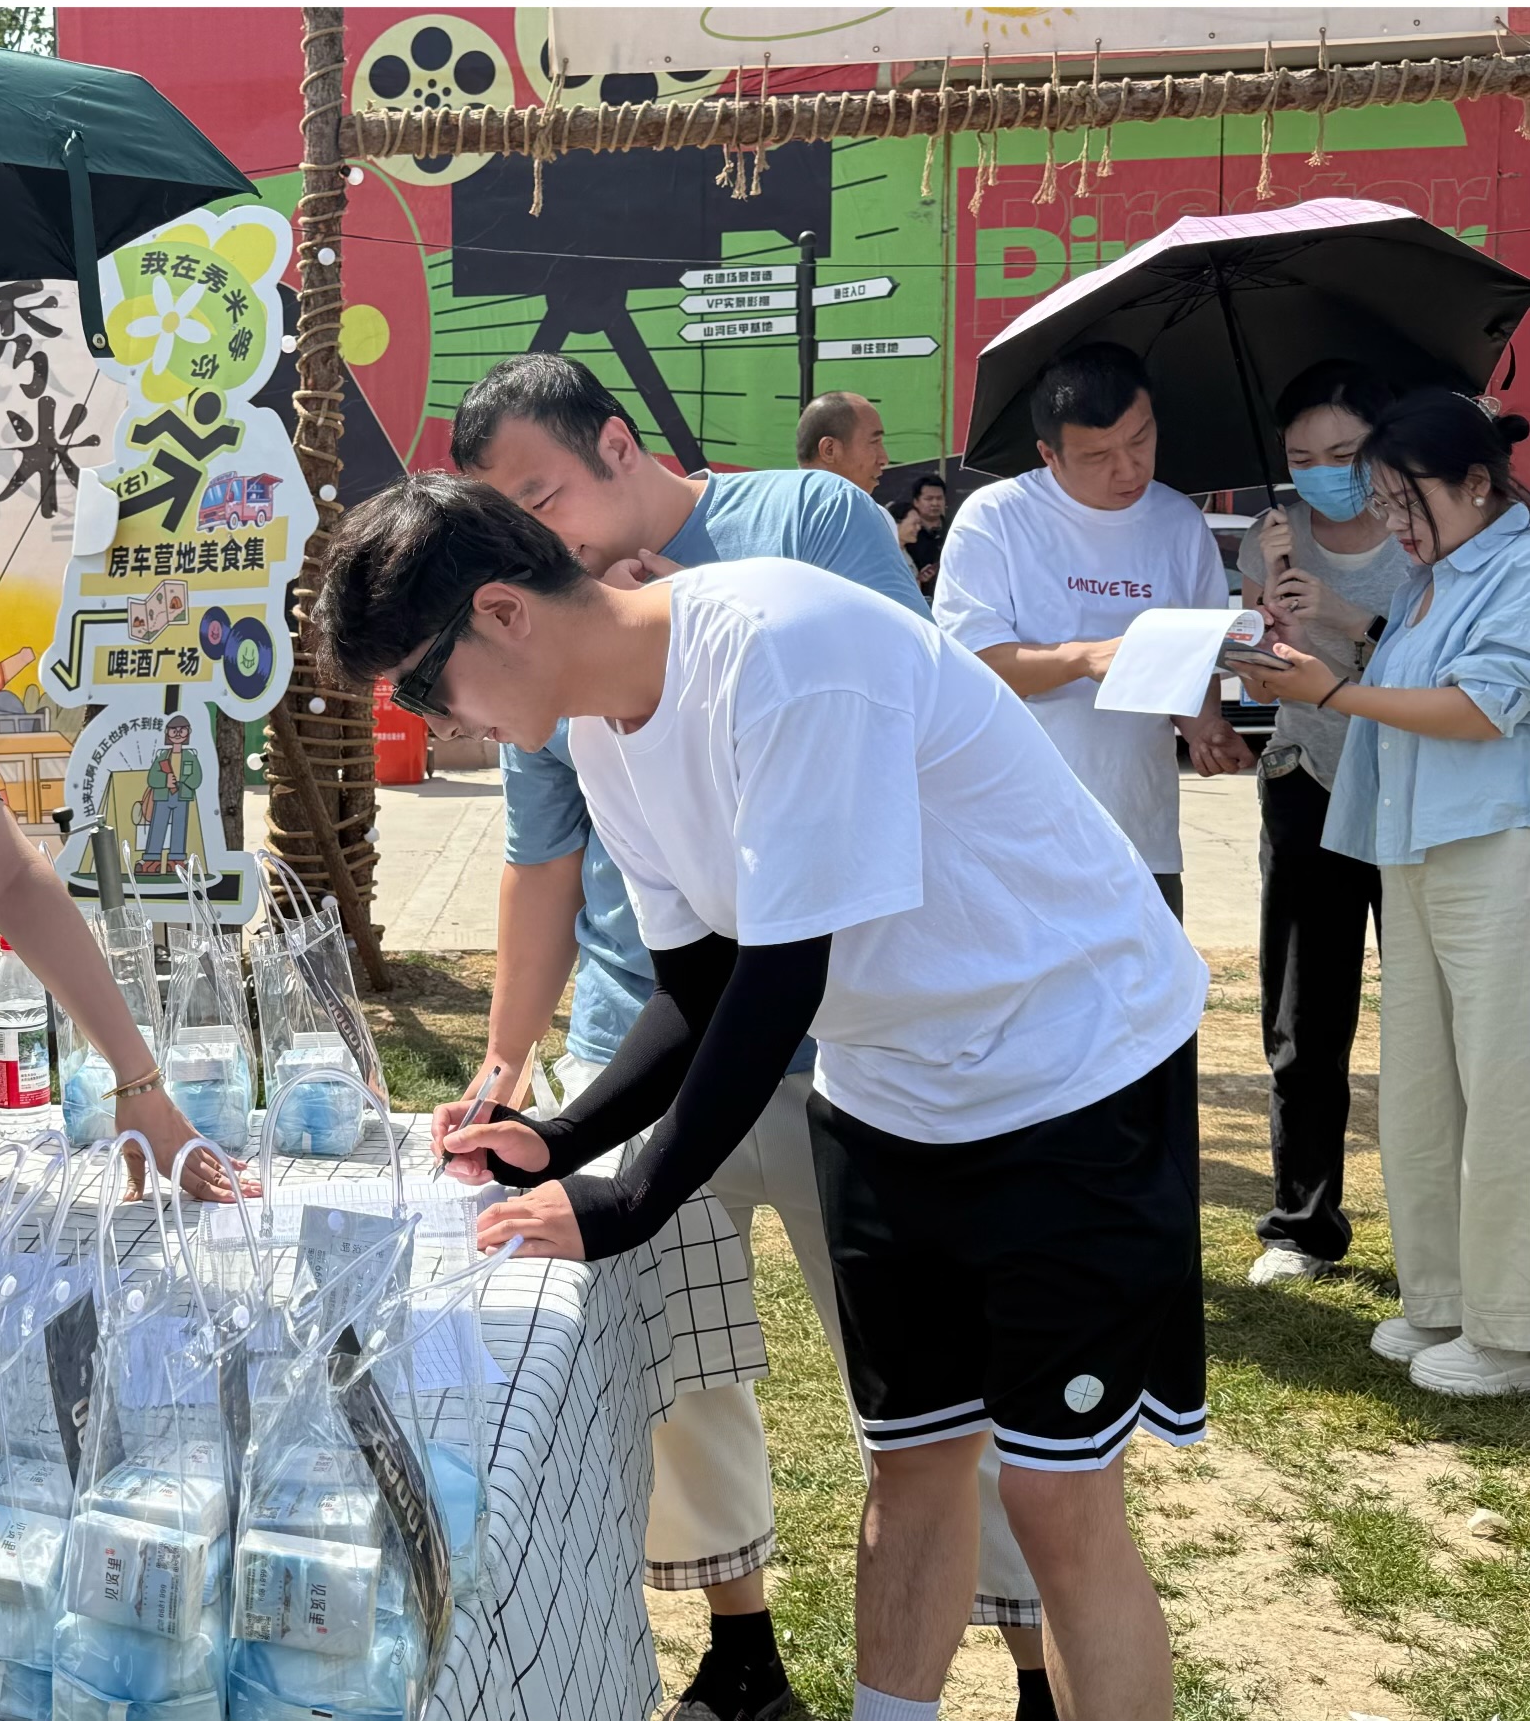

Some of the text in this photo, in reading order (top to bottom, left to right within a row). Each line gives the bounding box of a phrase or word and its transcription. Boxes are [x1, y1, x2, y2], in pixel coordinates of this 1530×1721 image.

[139, 249, 257, 380] 我在秀米等你
[703, 321, 774, 338] 山河巨甲基地
[851, 342, 899, 355] 通往营地
[107, 537, 265, 579] 房车营地美食集
[1067, 576, 1153, 600] UNIVETES
[106, 645, 201, 678] 啤酒广场
